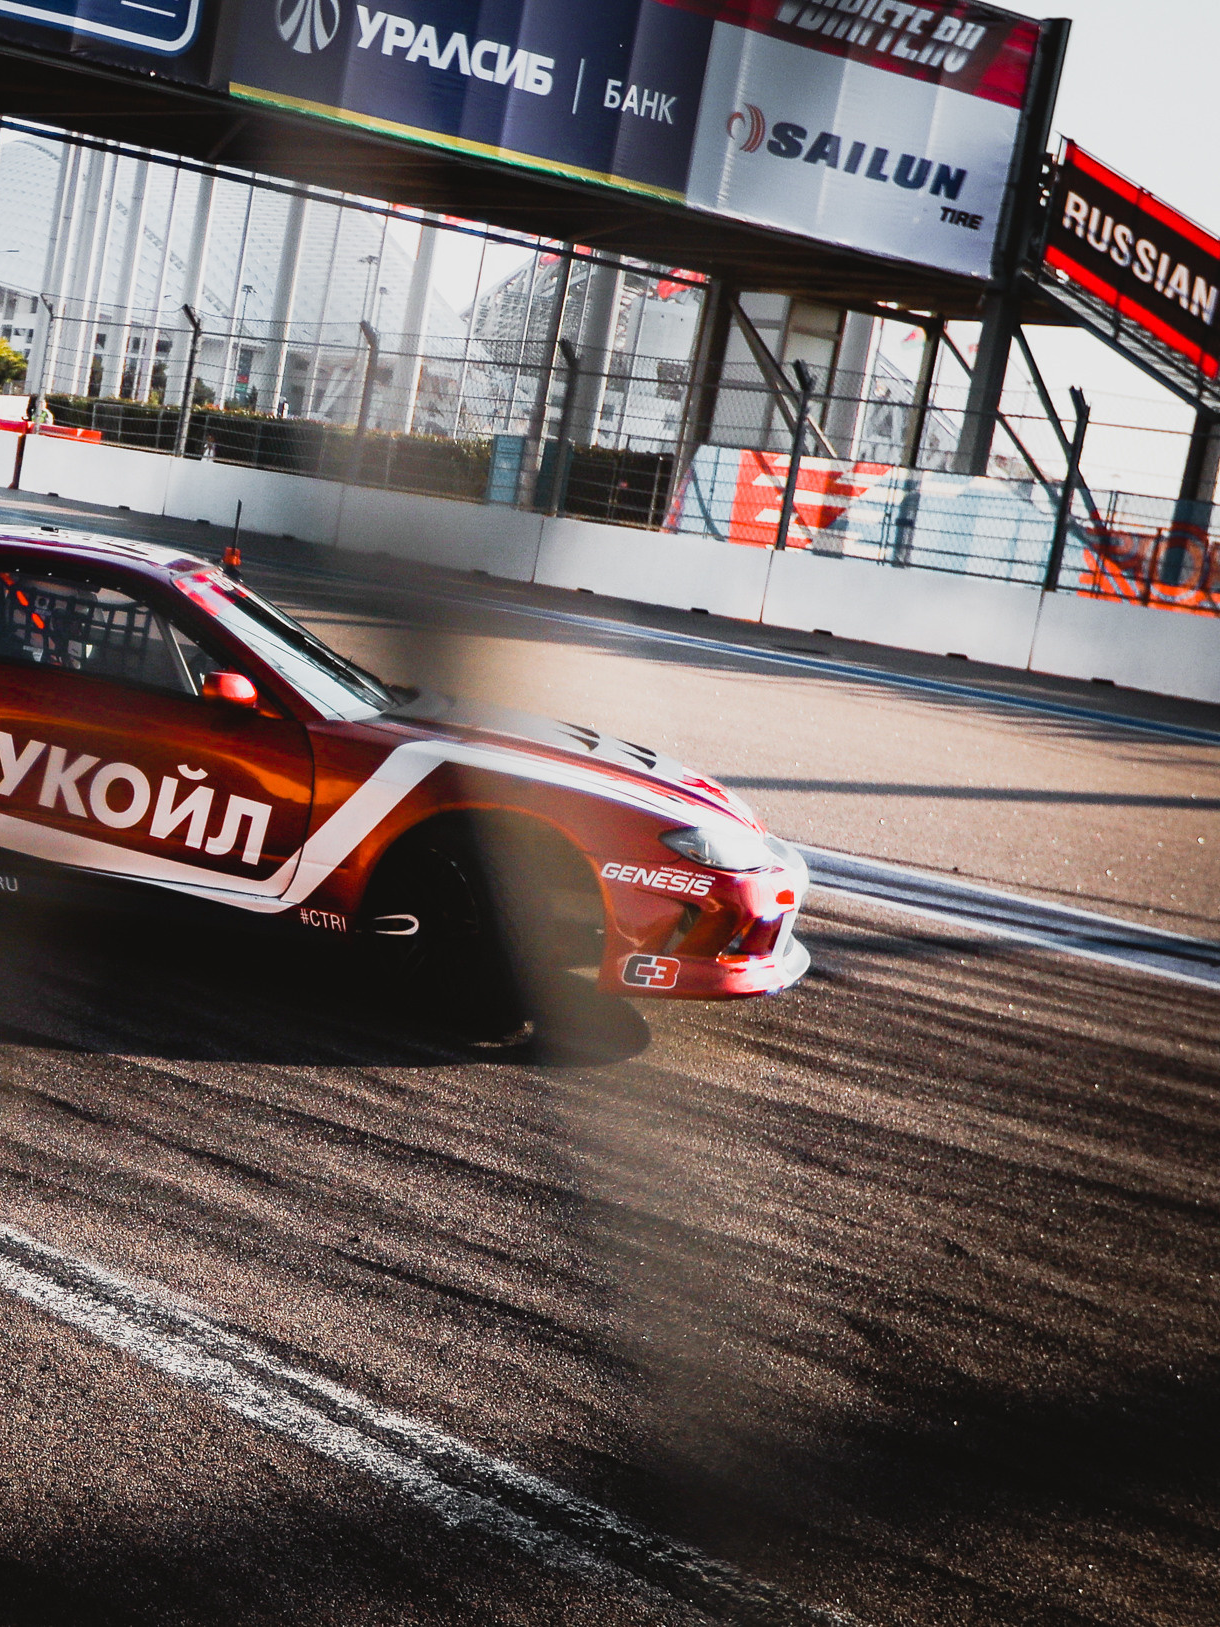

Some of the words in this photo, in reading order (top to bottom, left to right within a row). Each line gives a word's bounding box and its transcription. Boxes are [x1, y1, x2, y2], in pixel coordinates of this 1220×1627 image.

[356, 4, 555, 96] УРАЛСИБ
[603, 78, 677, 125] БАНК
[767, 121, 967, 200] SAILUN
[940, 206, 984, 230] TIRE
[1062, 190, 1219, 326] RUSSIAN
[601, 862, 713, 897] GENESIS
